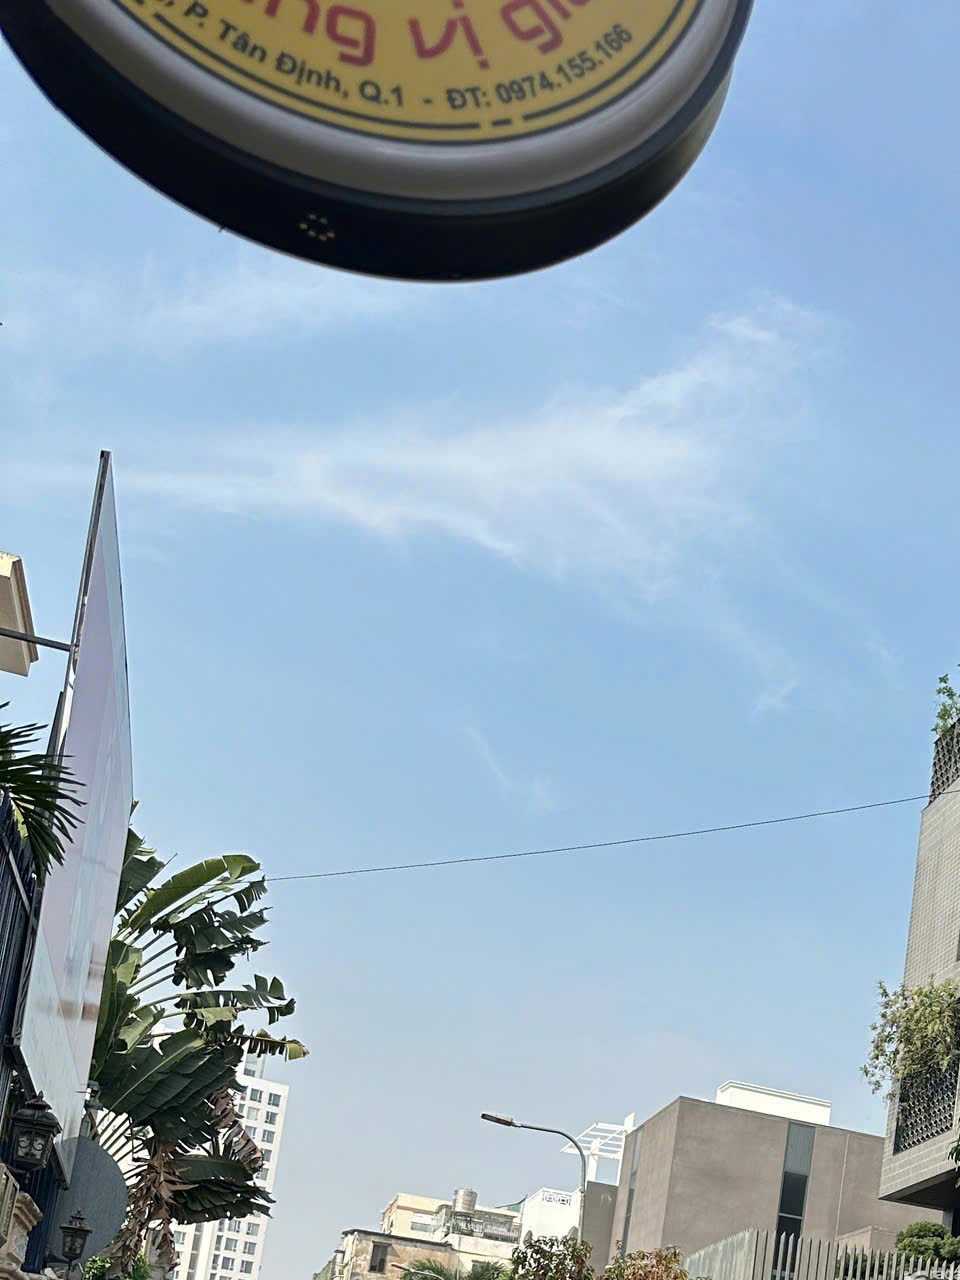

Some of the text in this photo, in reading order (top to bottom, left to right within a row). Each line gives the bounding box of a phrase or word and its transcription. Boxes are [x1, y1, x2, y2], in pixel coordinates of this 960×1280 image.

[219, 18, 268, 63] Tân
[274, 52, 349, 99] Định,
[359, 80, 404, 108] Q.1
[446, 86, 492, 110] ĐT:
[495, 23, 633, 105] 0974.155.166
[408, 0, 490, 70] vị
[501, 0, 592, 54] gi
